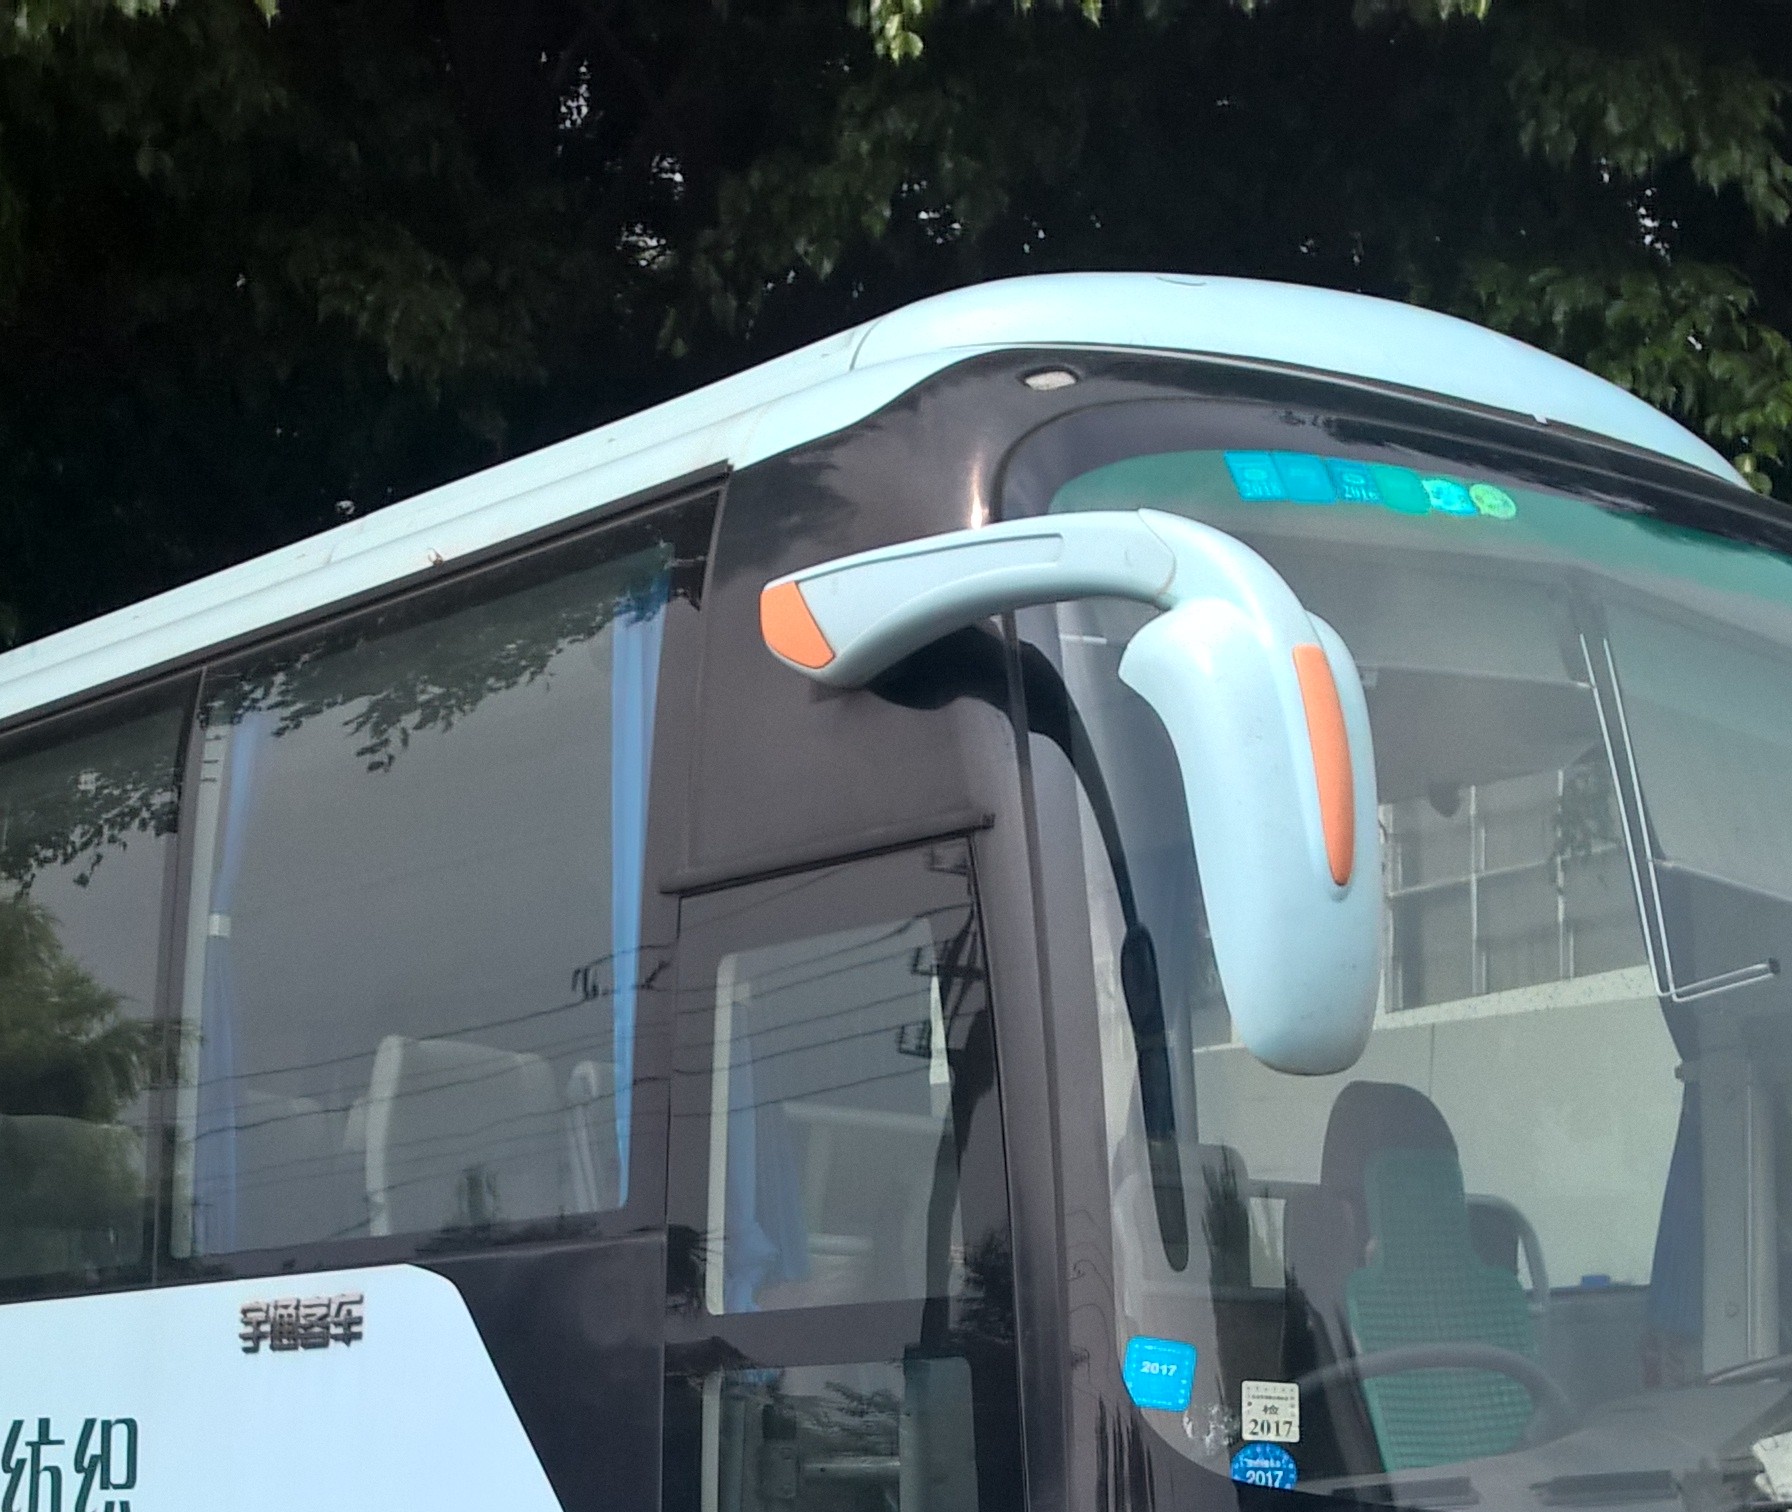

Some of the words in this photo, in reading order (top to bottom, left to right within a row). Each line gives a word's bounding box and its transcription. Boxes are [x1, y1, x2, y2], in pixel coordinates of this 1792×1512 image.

[239, 1292, 364, 1353] 宇通客车
[1140, 1360, 1178, 1377] 2017
[1248, 1418, 1293, 1438] 2017
[1245, 1469, 1284, 1489] 2017
